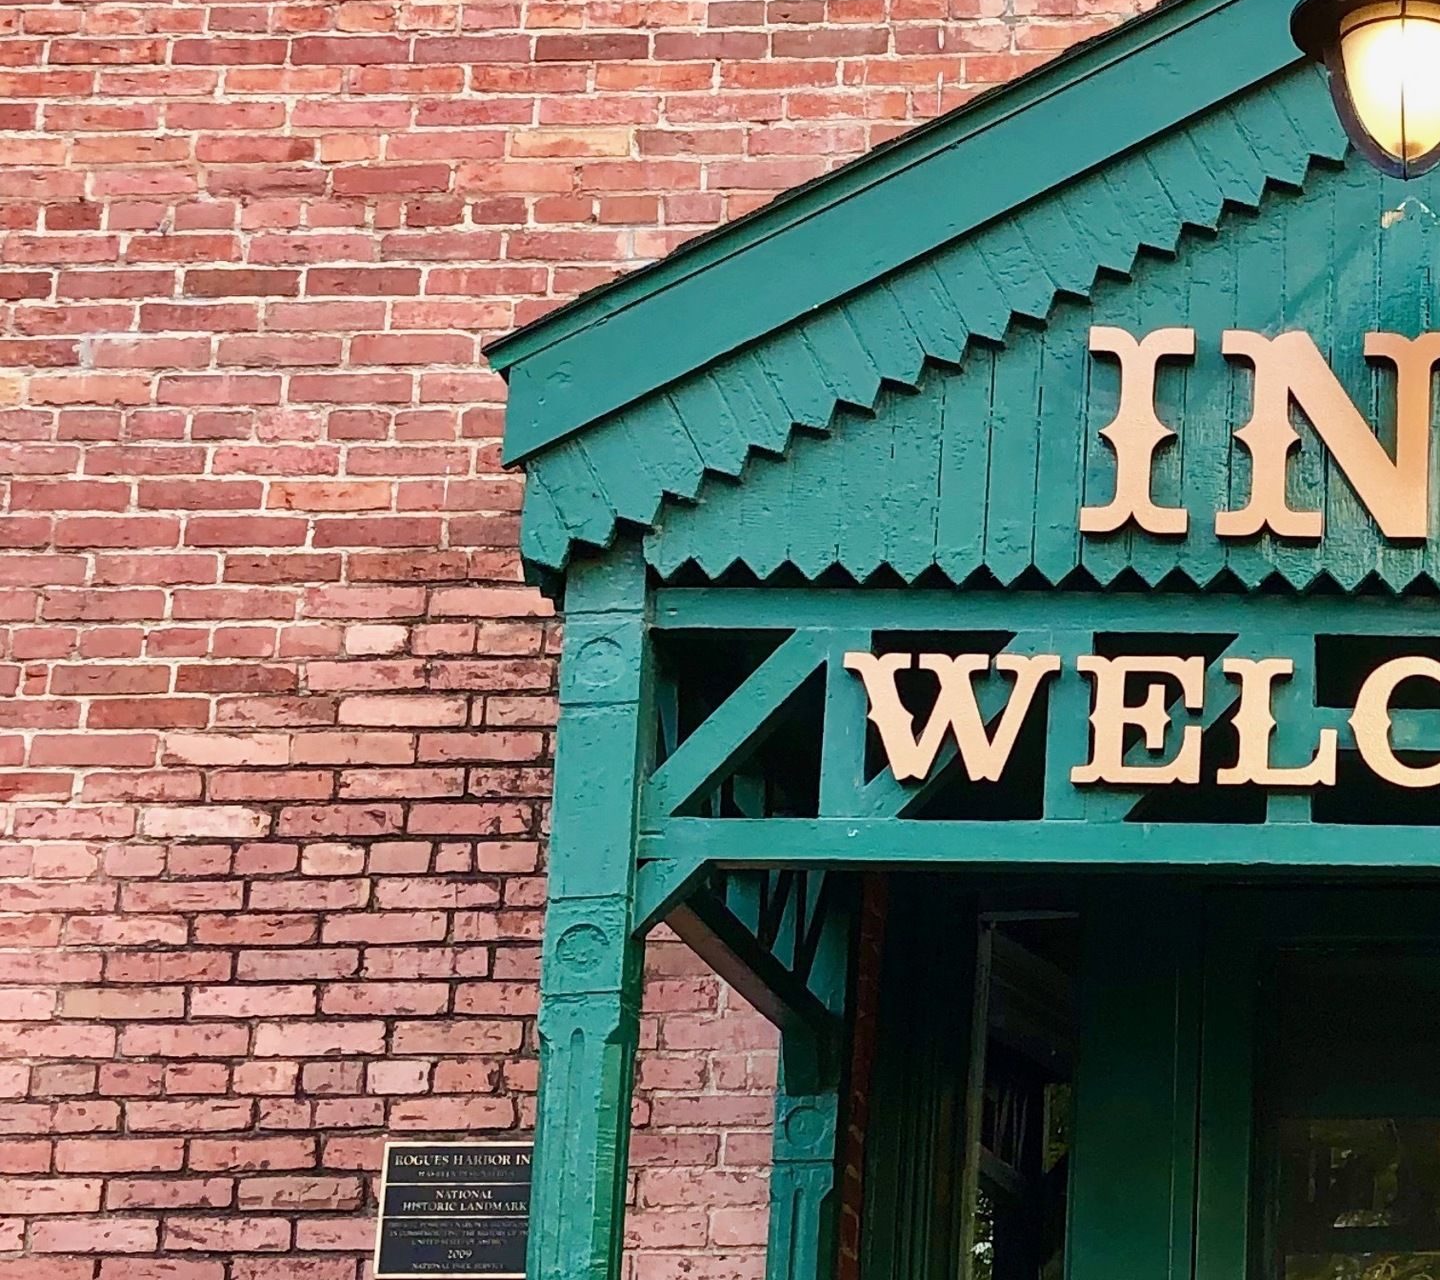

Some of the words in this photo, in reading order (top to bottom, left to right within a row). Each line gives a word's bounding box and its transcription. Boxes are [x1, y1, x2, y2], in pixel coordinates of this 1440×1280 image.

[453, 1154, 511, 1166] HARBOR
[435, 1190, 494, 1200] NATIONAL
[402, 1202, 457, 1212] HISTORIC
[460, 1201, 527, 1211] LANDMARK
